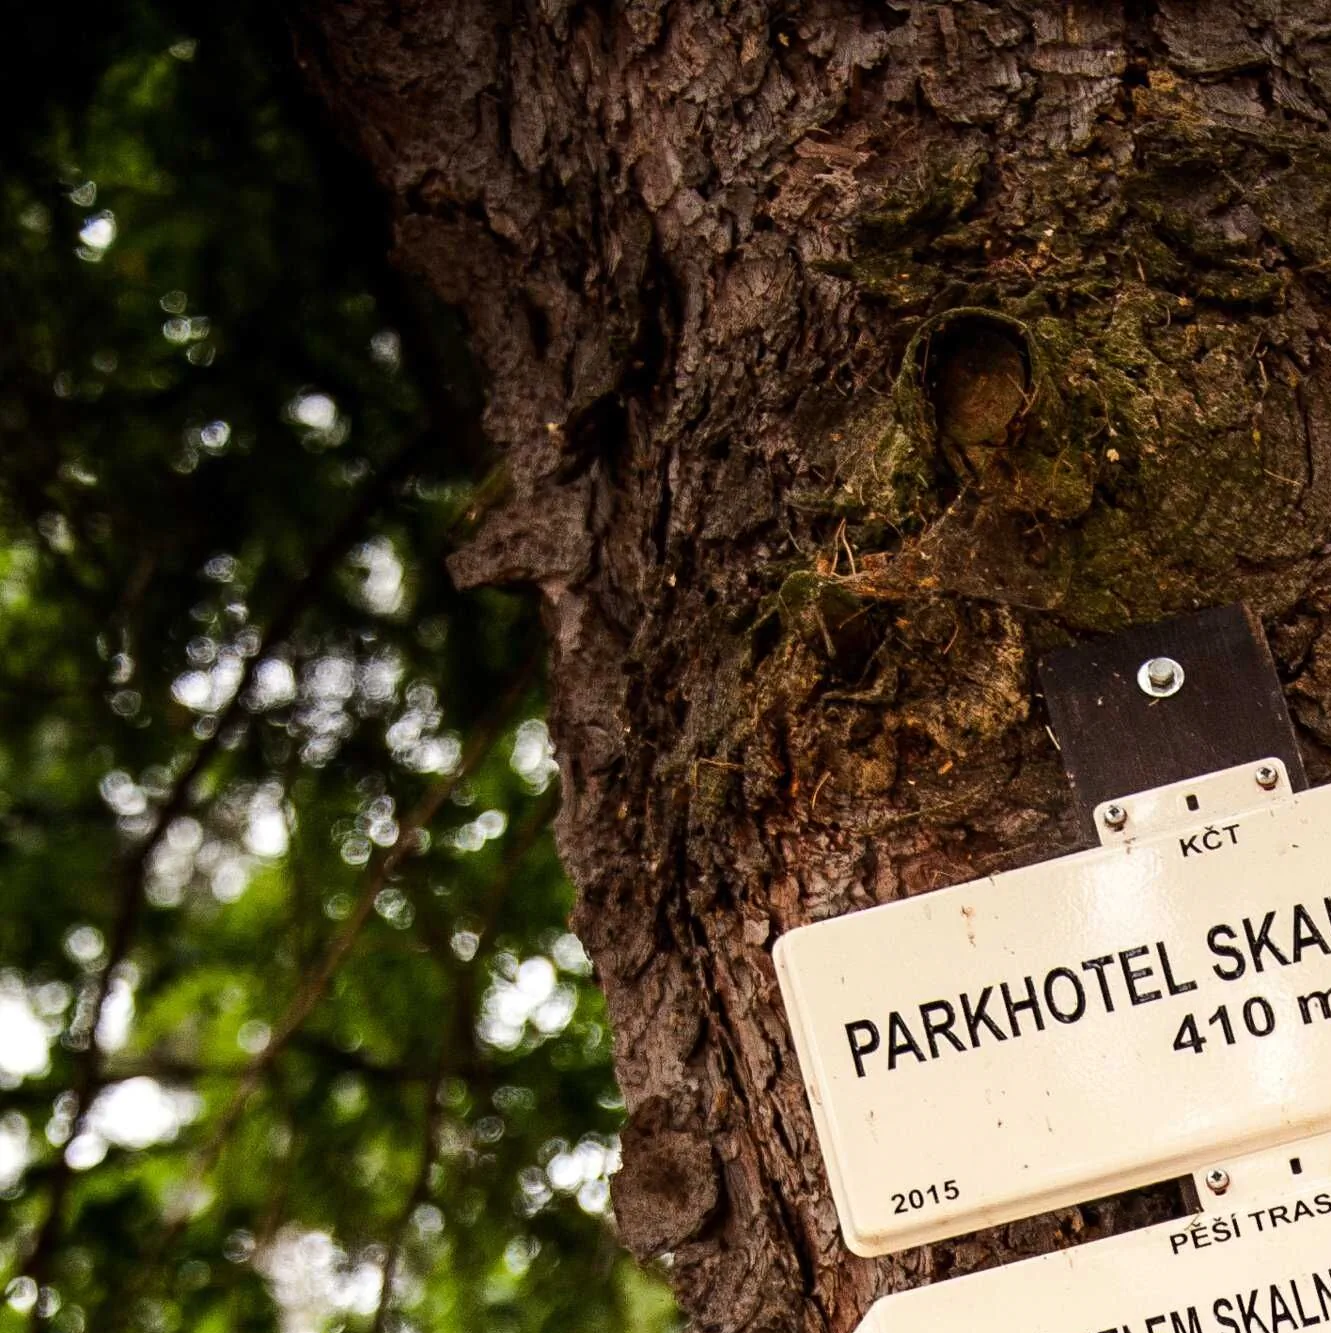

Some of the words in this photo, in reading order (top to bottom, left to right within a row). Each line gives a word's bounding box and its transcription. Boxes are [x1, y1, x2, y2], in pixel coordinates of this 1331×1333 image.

[1178, 822, 1241, 859] KČT
[843, 940, 1199, 1080] PARKHOTEL
[1171, 995, 1277, 1055] 410
[890, 1178, 961, 1216] 2015
[1168, 1217, 1242, 1256] PĚŠÍ
